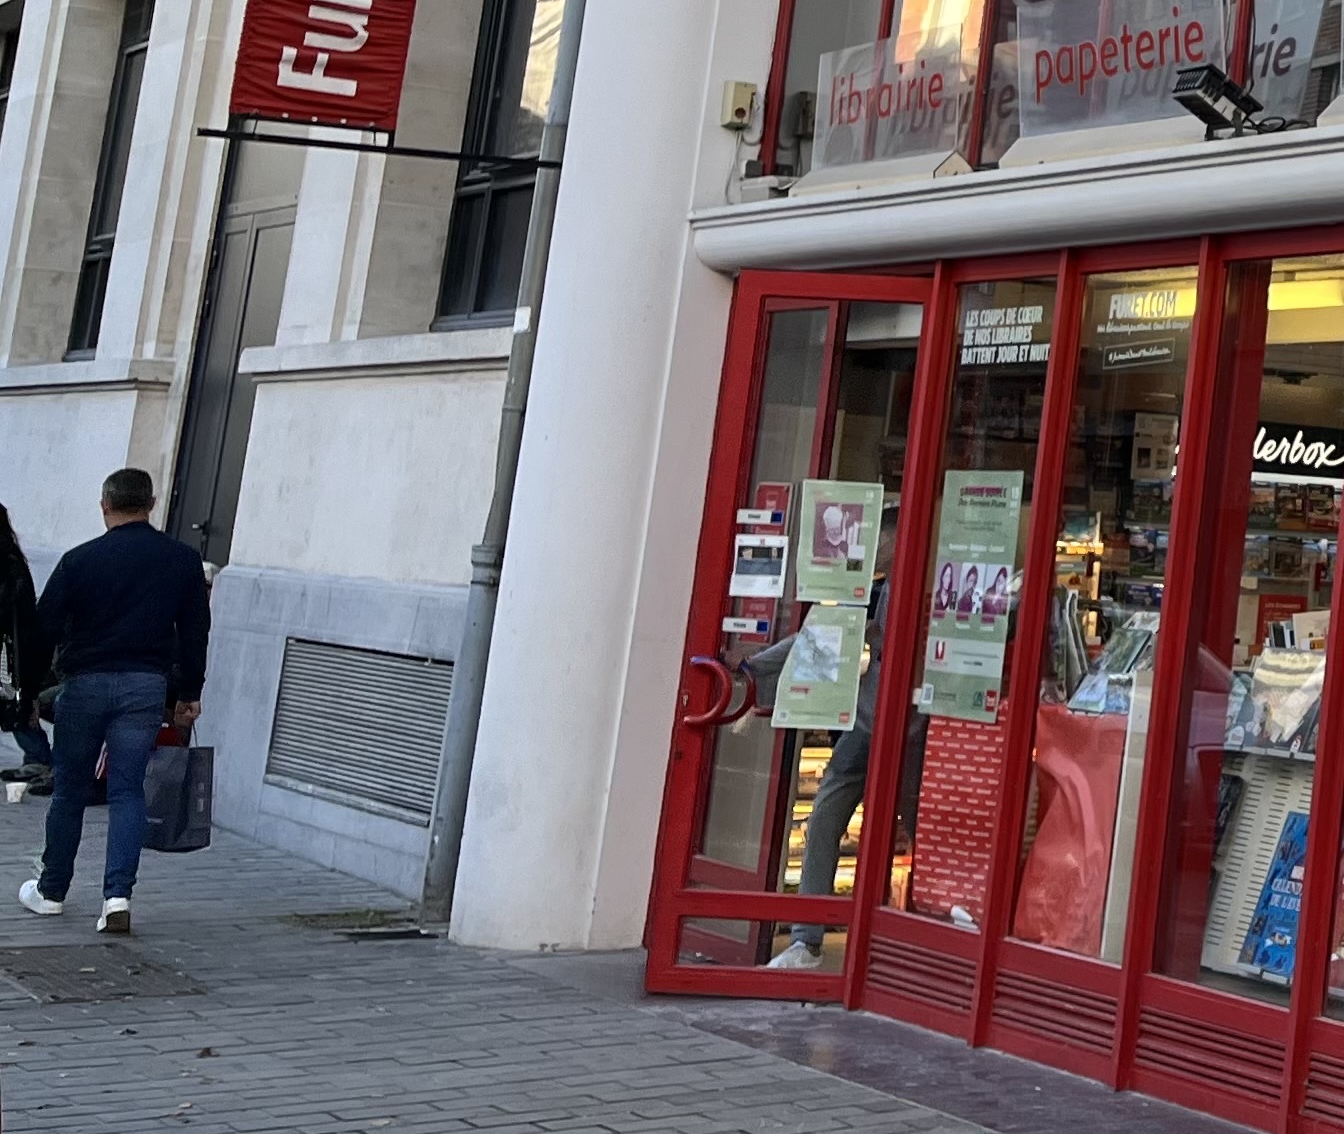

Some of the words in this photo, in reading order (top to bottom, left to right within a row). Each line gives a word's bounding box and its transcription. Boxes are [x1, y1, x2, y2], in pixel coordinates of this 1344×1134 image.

[1034, 6, 1206, 104] papeterie
[829, 60, 945, 127] librairie
[966, 310, 979, 327] LES
[980, 308, 1005, 326] COUPS
[1006, 307, 1018, 325] DE
[963, 329, 975, 346] DE
[975, 327, 991, 346] NOS
[991, 325, 1033, 345] LIBRAIRES
[961, 346, 997, 365] BATTENT
[996, 345, 1018, 363] JOUR
[1019, 345, 1030, 362] ET
